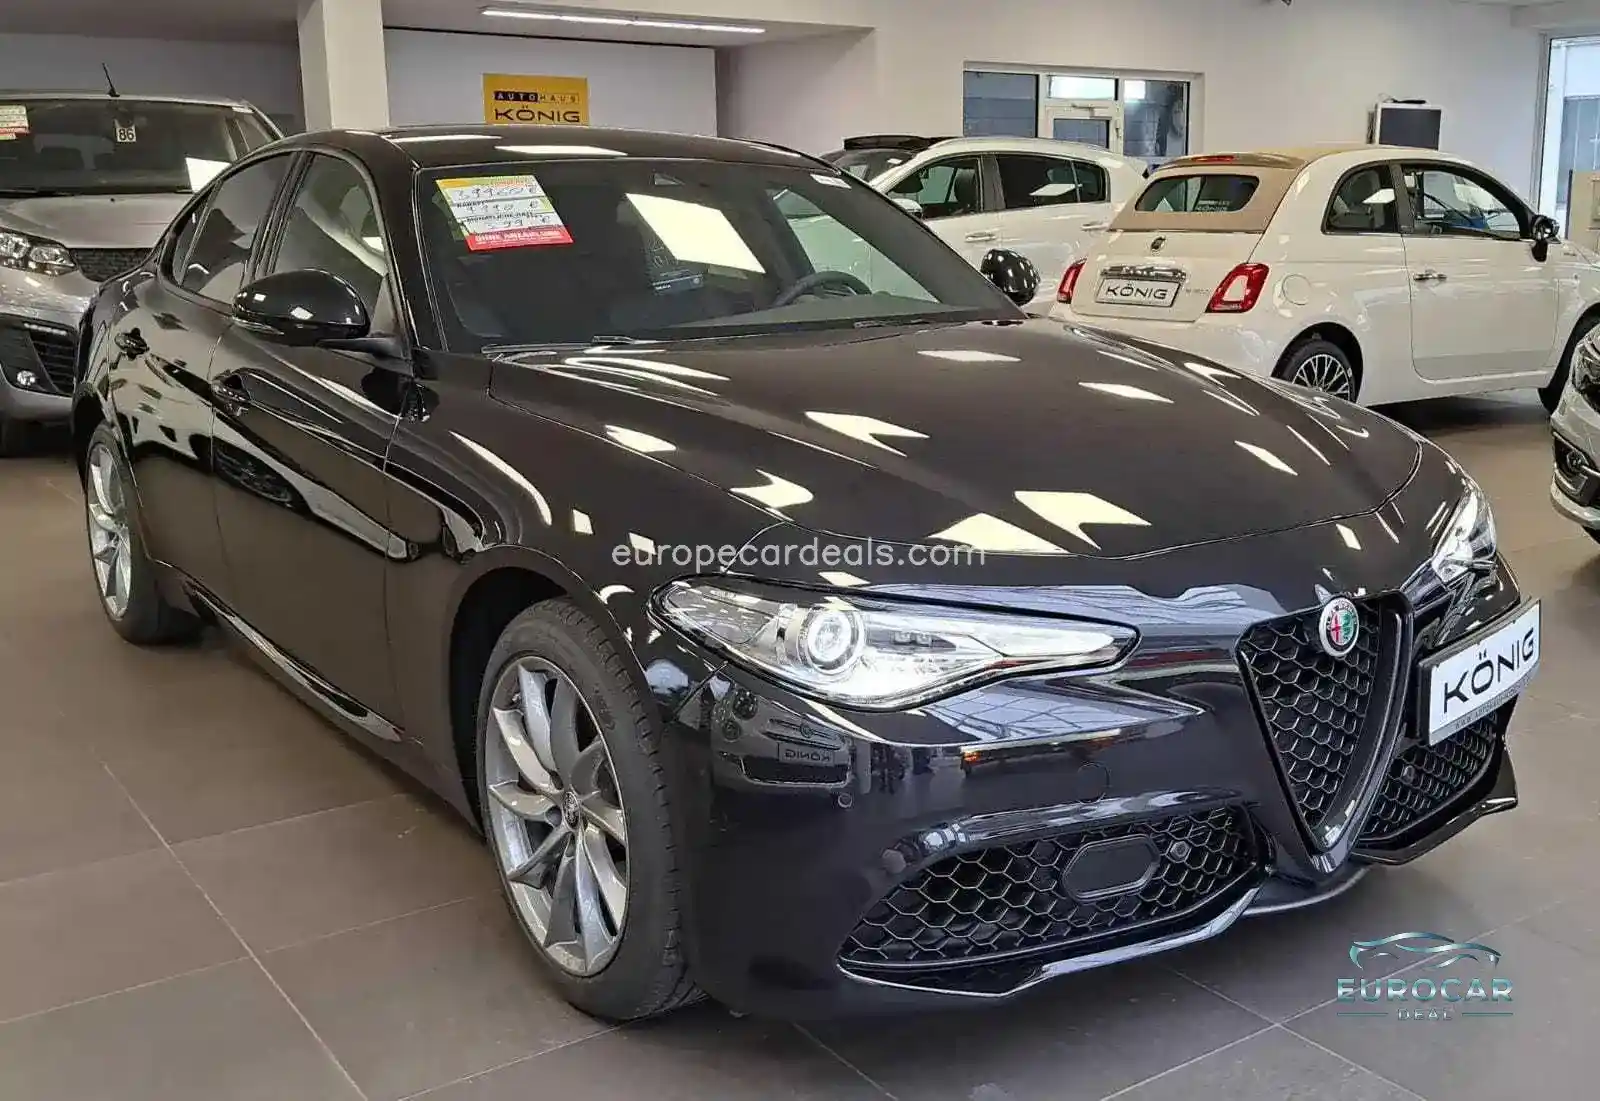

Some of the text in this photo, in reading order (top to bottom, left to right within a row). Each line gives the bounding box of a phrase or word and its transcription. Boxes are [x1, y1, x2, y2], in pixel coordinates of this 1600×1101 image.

[494, 104, 580, 123] KÖNIG
[118, 128, 135, 141] 86
[1105, 283, 1168, 300] KÖNIG
[1444, 627, 1534, 714] KÖNIG
